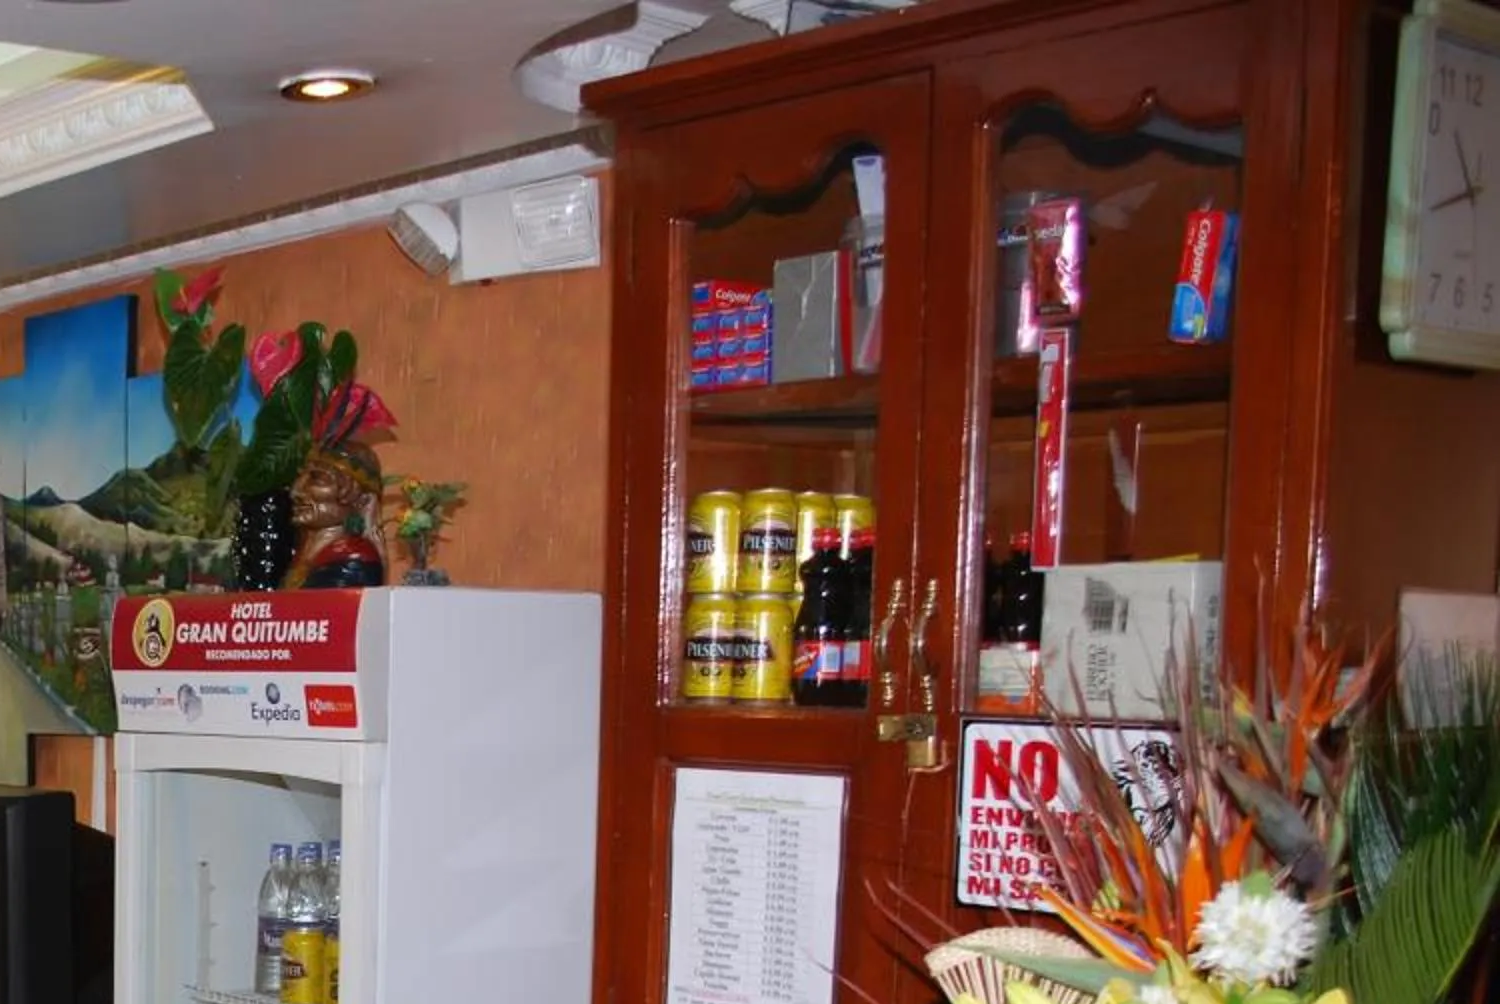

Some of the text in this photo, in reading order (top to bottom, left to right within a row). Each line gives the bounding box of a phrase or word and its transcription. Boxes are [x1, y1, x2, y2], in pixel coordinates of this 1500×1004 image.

[1464, 73, 1484, 108] 12
[231, 602, 273, 619] HOTEL
[176, 619, 329, 644] GRAN QUITUMBE
[251, 702, 300, 726] Expedia
[972, 739, 1059, 801] NO
[970, 829, 998, 848] MI
[969, 853, 991, 872] SI
[1000, 855, 1030, 875] NO
[967, 876, 1001, 896] MI
